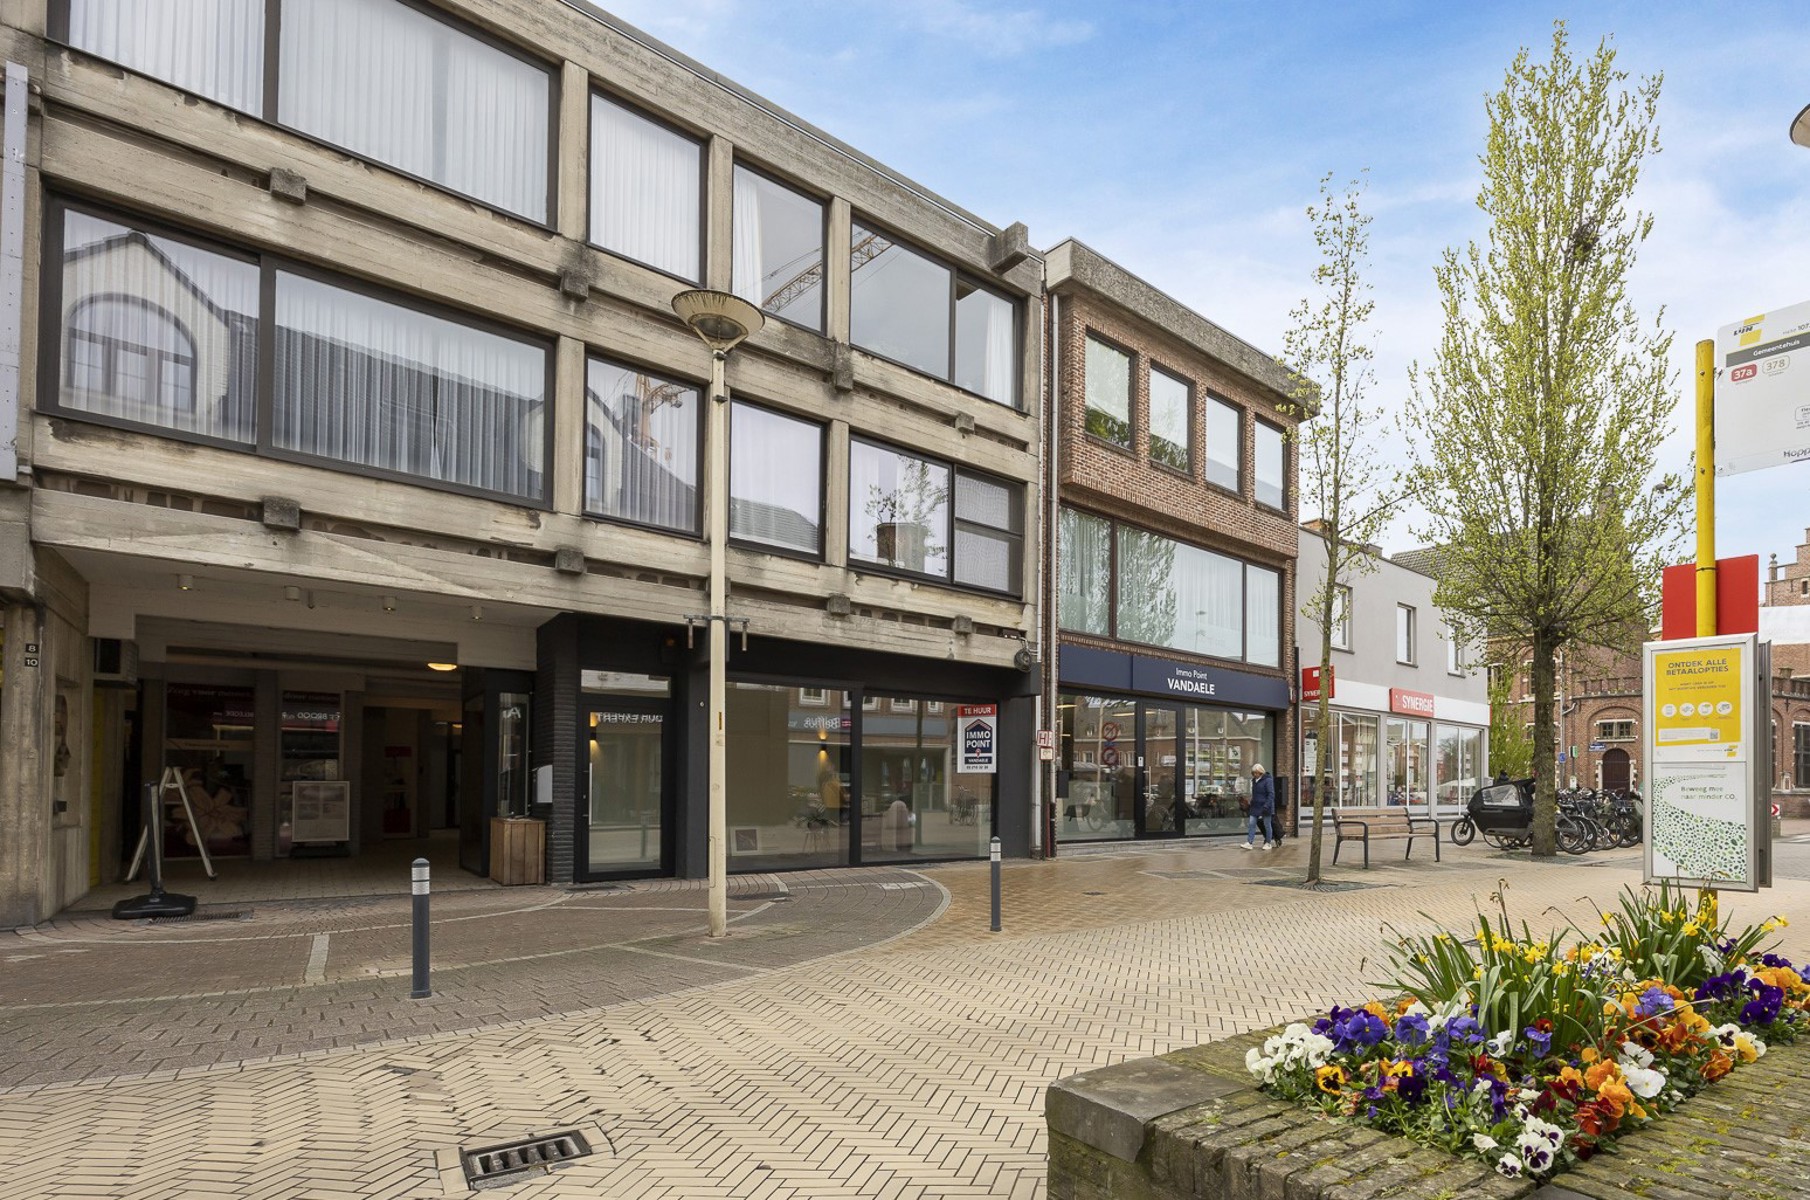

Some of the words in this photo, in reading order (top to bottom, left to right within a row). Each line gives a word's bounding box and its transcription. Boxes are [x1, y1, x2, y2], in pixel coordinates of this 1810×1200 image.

[1753, 339, 1800, 356] Gemeentehuis
[1766, 359, 1785, 371] 378
[26, 659, 38, 667] 10
[1668, 660, 1703, 669] ONTDEK
[1705, 658, 1727, 666] ALLE
[1175, 667, 1192, 678] Immo
[1193, 669, 1208, 681] Point
[1666, 665, 1729, 676] BETAALOPTIES
[1167, 677, 1216, 696] VANDAELE
[1402, 694, 1434, 713] SYNERGIE
[973, 706, 992, 714] HUUR
[966, 730, 991, 739] IMMO
[966, 739, 991, 748] POINT
